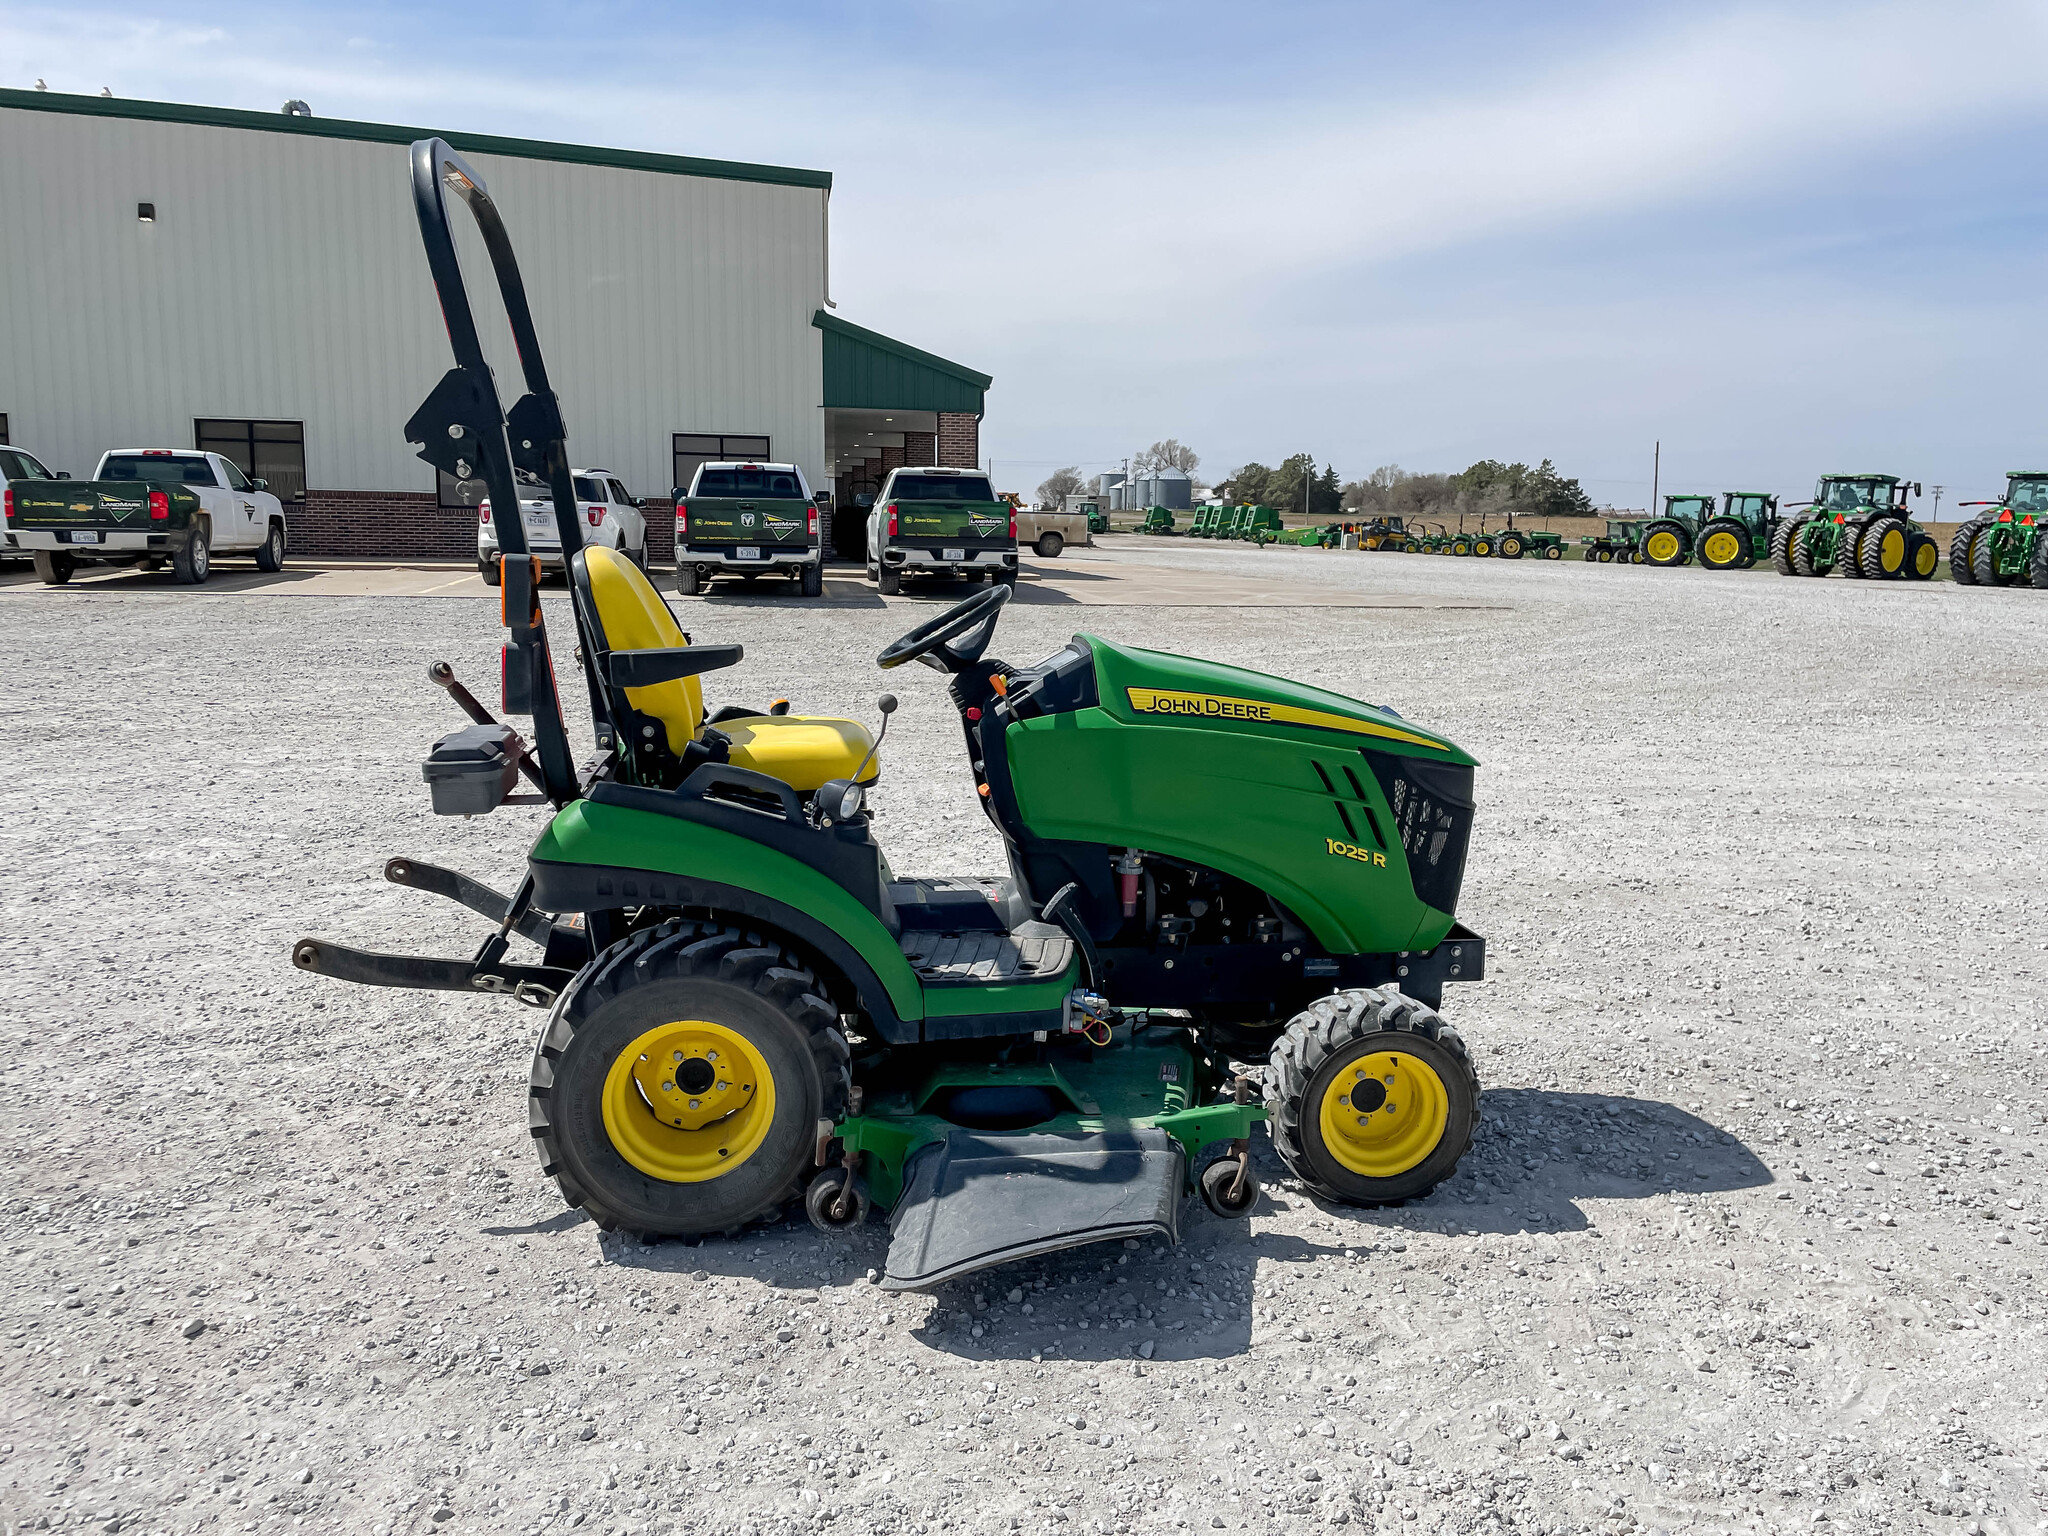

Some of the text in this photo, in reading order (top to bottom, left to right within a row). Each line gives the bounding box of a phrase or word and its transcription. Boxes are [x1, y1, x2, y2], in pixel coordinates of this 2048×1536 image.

[1146, 695, 1271, 720] JOHN DEERE
[1325, 838, 1386, 868] 1025 R
